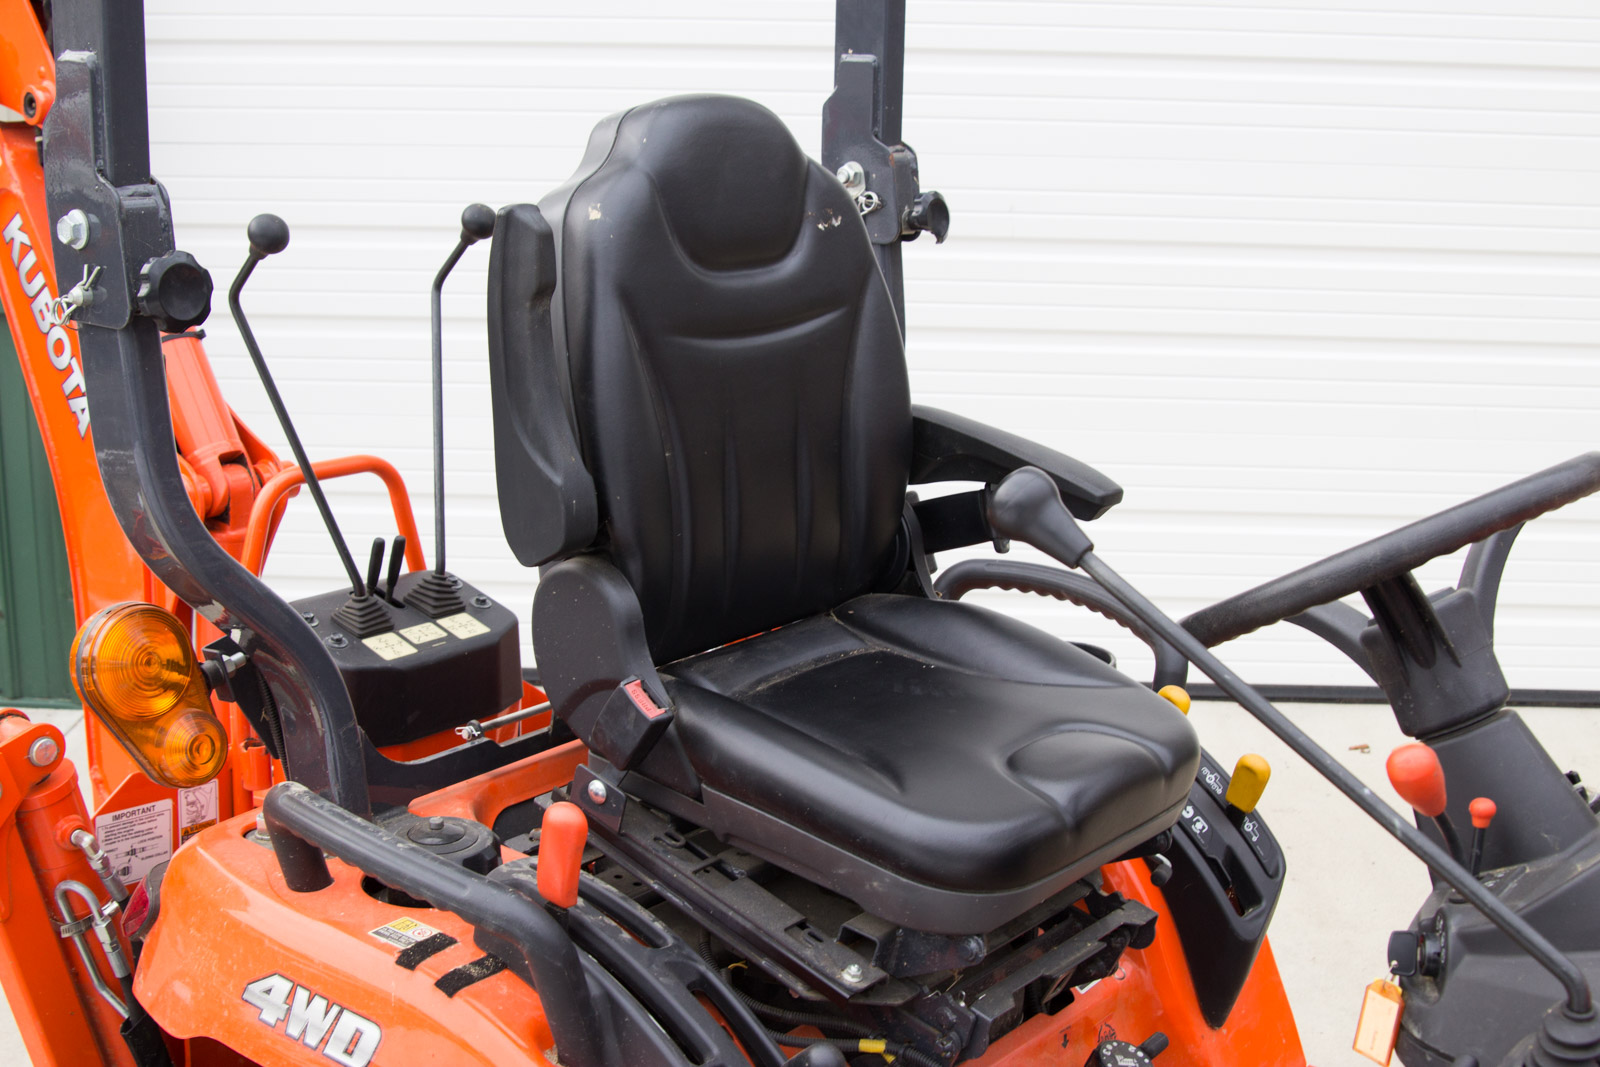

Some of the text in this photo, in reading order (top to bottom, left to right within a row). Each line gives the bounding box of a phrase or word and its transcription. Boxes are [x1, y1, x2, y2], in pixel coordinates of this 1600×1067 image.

[3, 212, 91, 439] KUBOTA
[112, 804, 156, 822] IMPORTANT
[242, 973, 382, 1067] 4WD
